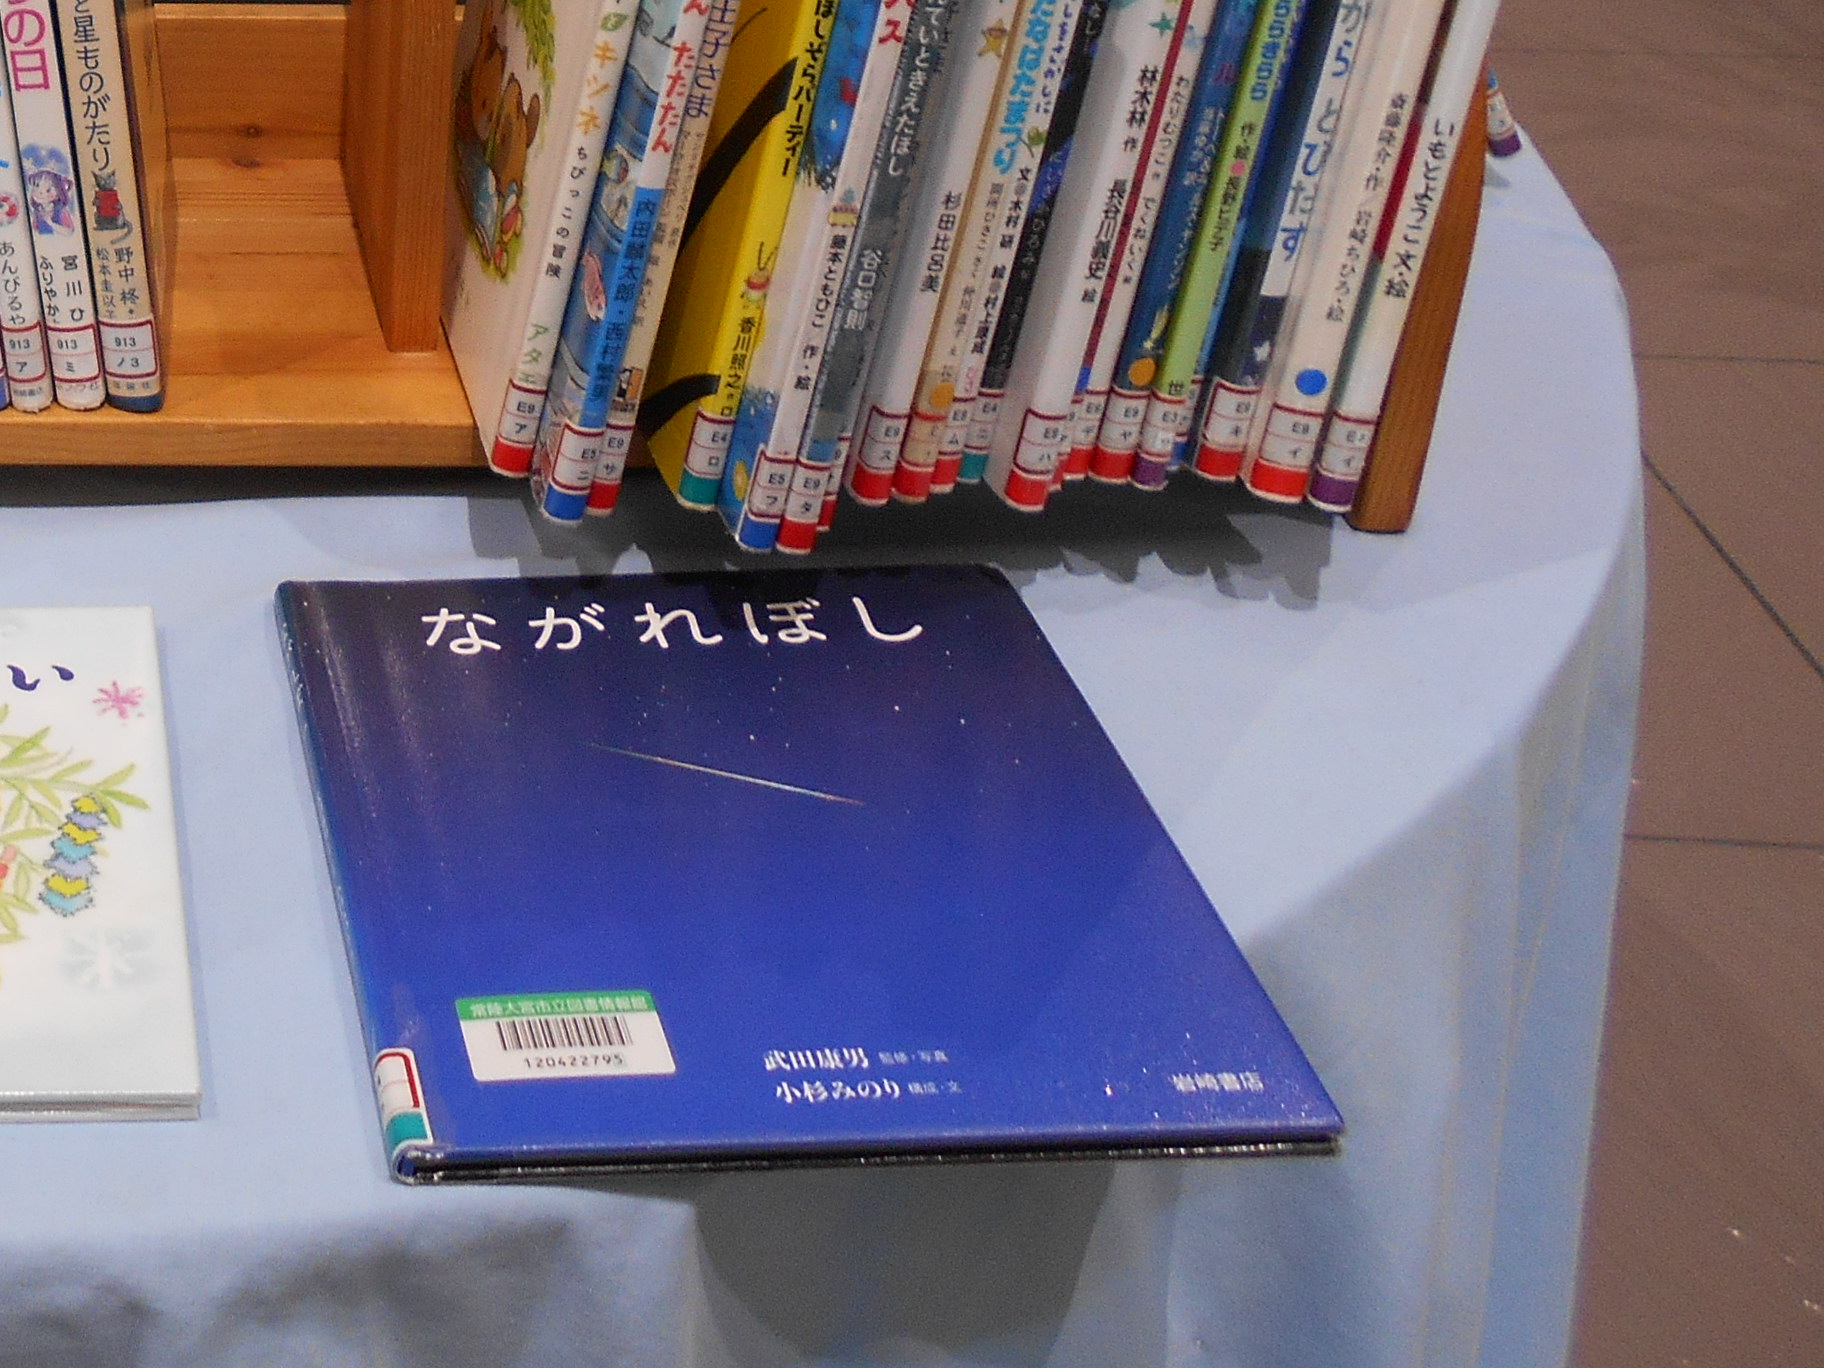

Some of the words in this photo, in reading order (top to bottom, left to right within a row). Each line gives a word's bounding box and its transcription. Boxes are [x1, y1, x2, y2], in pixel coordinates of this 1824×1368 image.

[650, 40, 696, 154] たたたん
[1126, 65, 1159, 128] 林木林
[544, 145, 588, 280] ちびっこの冒険
[920, 190, 961, 294] 杉田比呂美
[9, 338, 31, 351] 913
[57, 339, 78, 351] 913
[114, 336, 137, 348] 913
[17, 361, 28, 373] ア
[516, 401, 536, 414] E9
[607, 436, 625, 449] E9
[711, 432, 727, 444] E4
[580, 447, 597, 460] E5
[601, 460, 617, 476] サ
[768, 473, 786, 485] E5
[802, 478, 821, 490] E9
[421, 596, 924, 656] ながれぼし
[523, 1053, 625, 1069] 120422795
[764, 1046, 870, 1071] 武田康男
[775, 1078, 903, 1104] 小杉みのり
